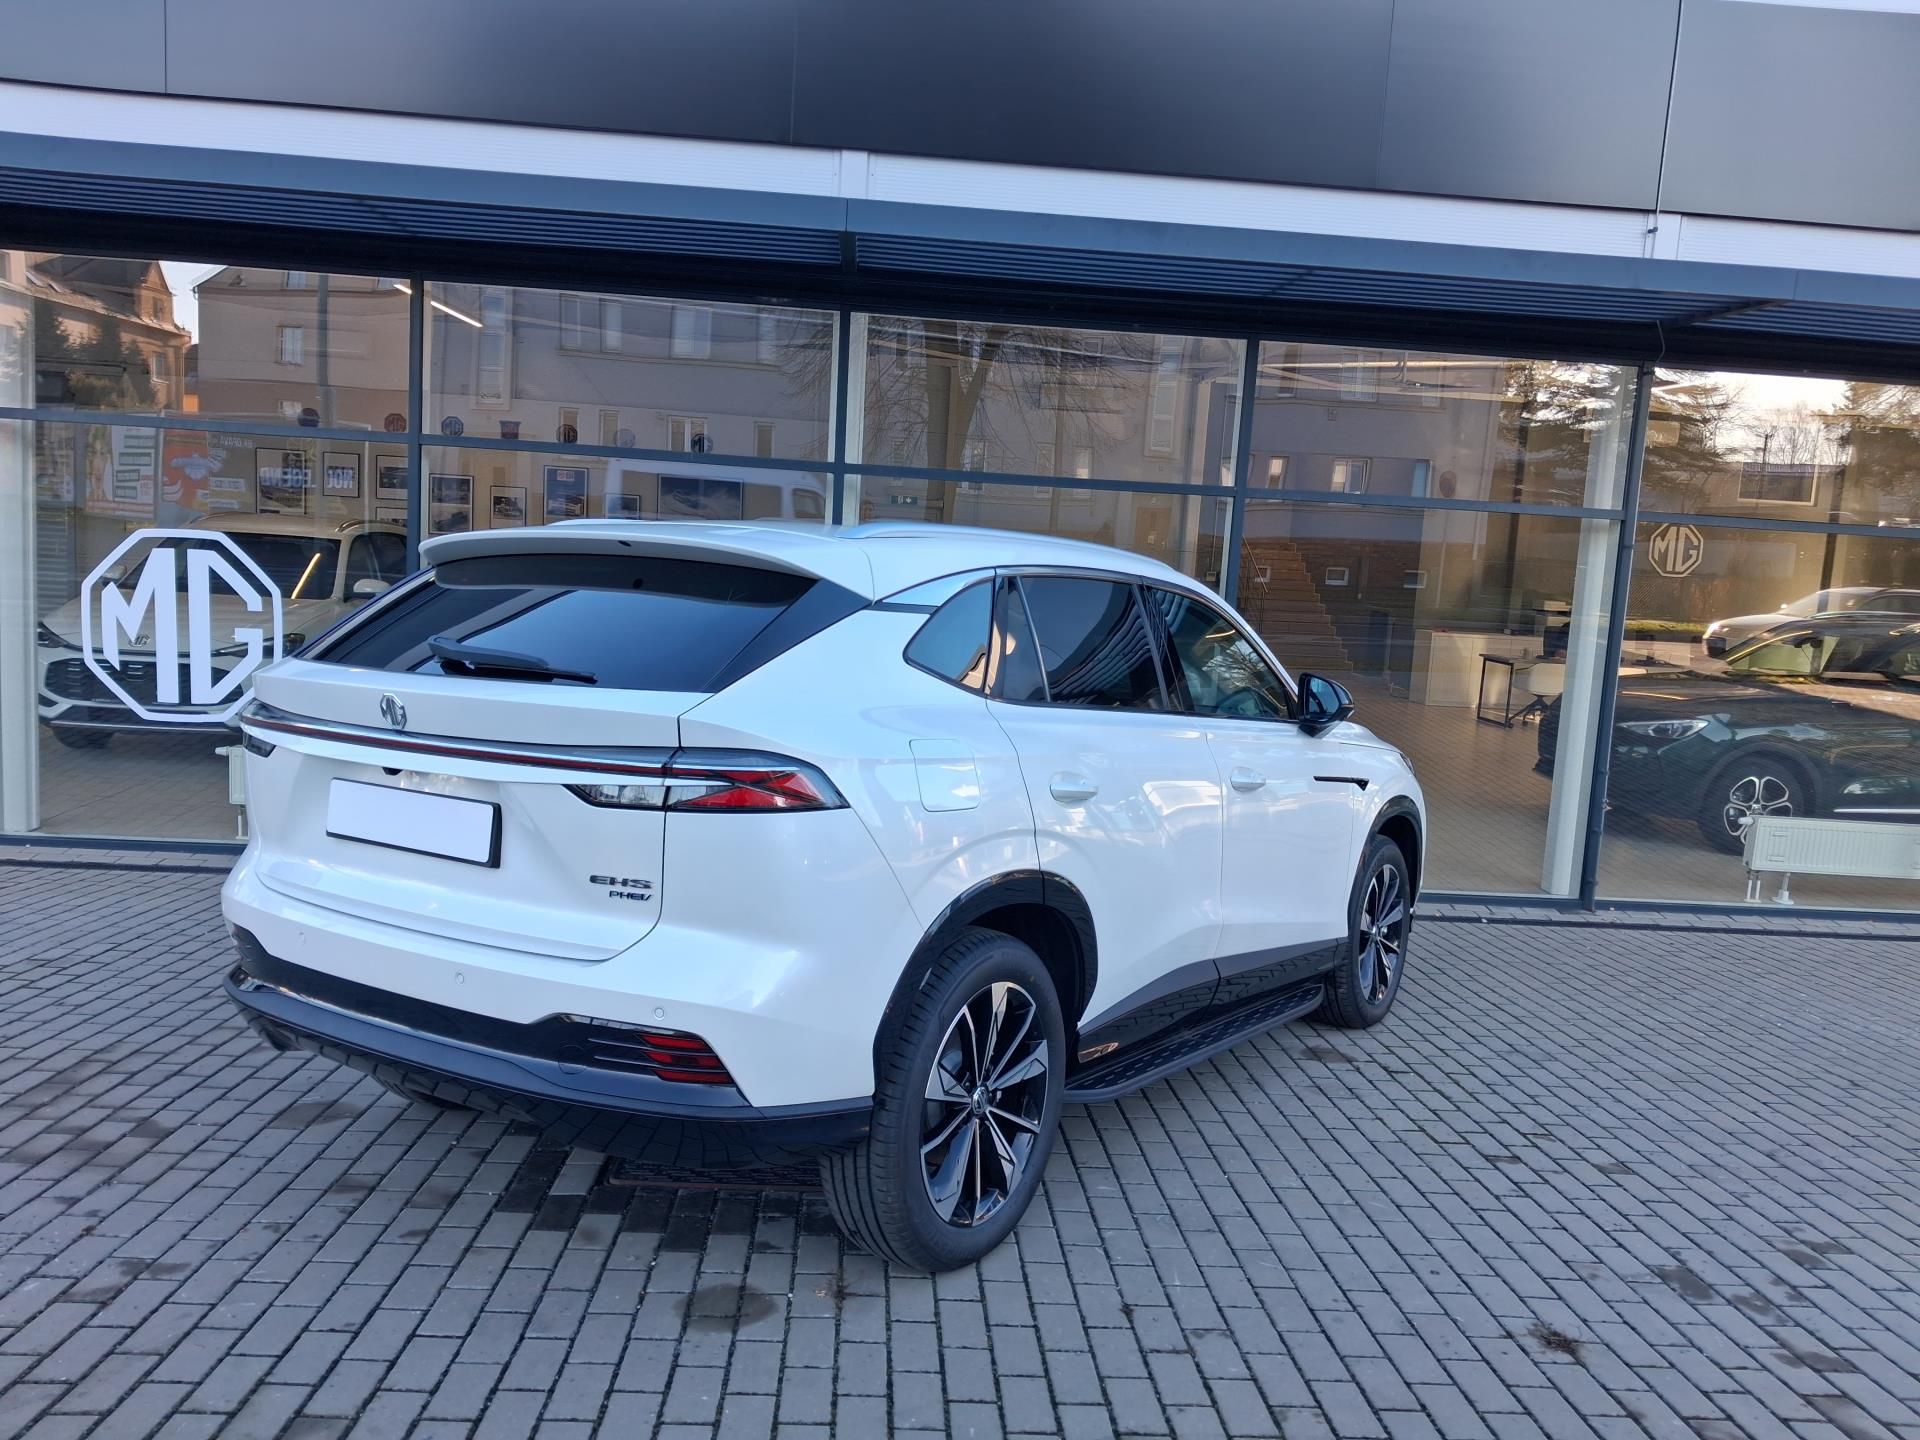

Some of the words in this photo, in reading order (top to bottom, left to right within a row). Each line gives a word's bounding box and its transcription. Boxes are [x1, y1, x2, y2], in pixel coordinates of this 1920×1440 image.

[1653, 526, 1699, 572] MG
[101, 547, 263, 705] MG
[381, 696, 405, 727] MG
[589, 875, 653, 889] EHS
[609, 890, 653, 901] PHEV
